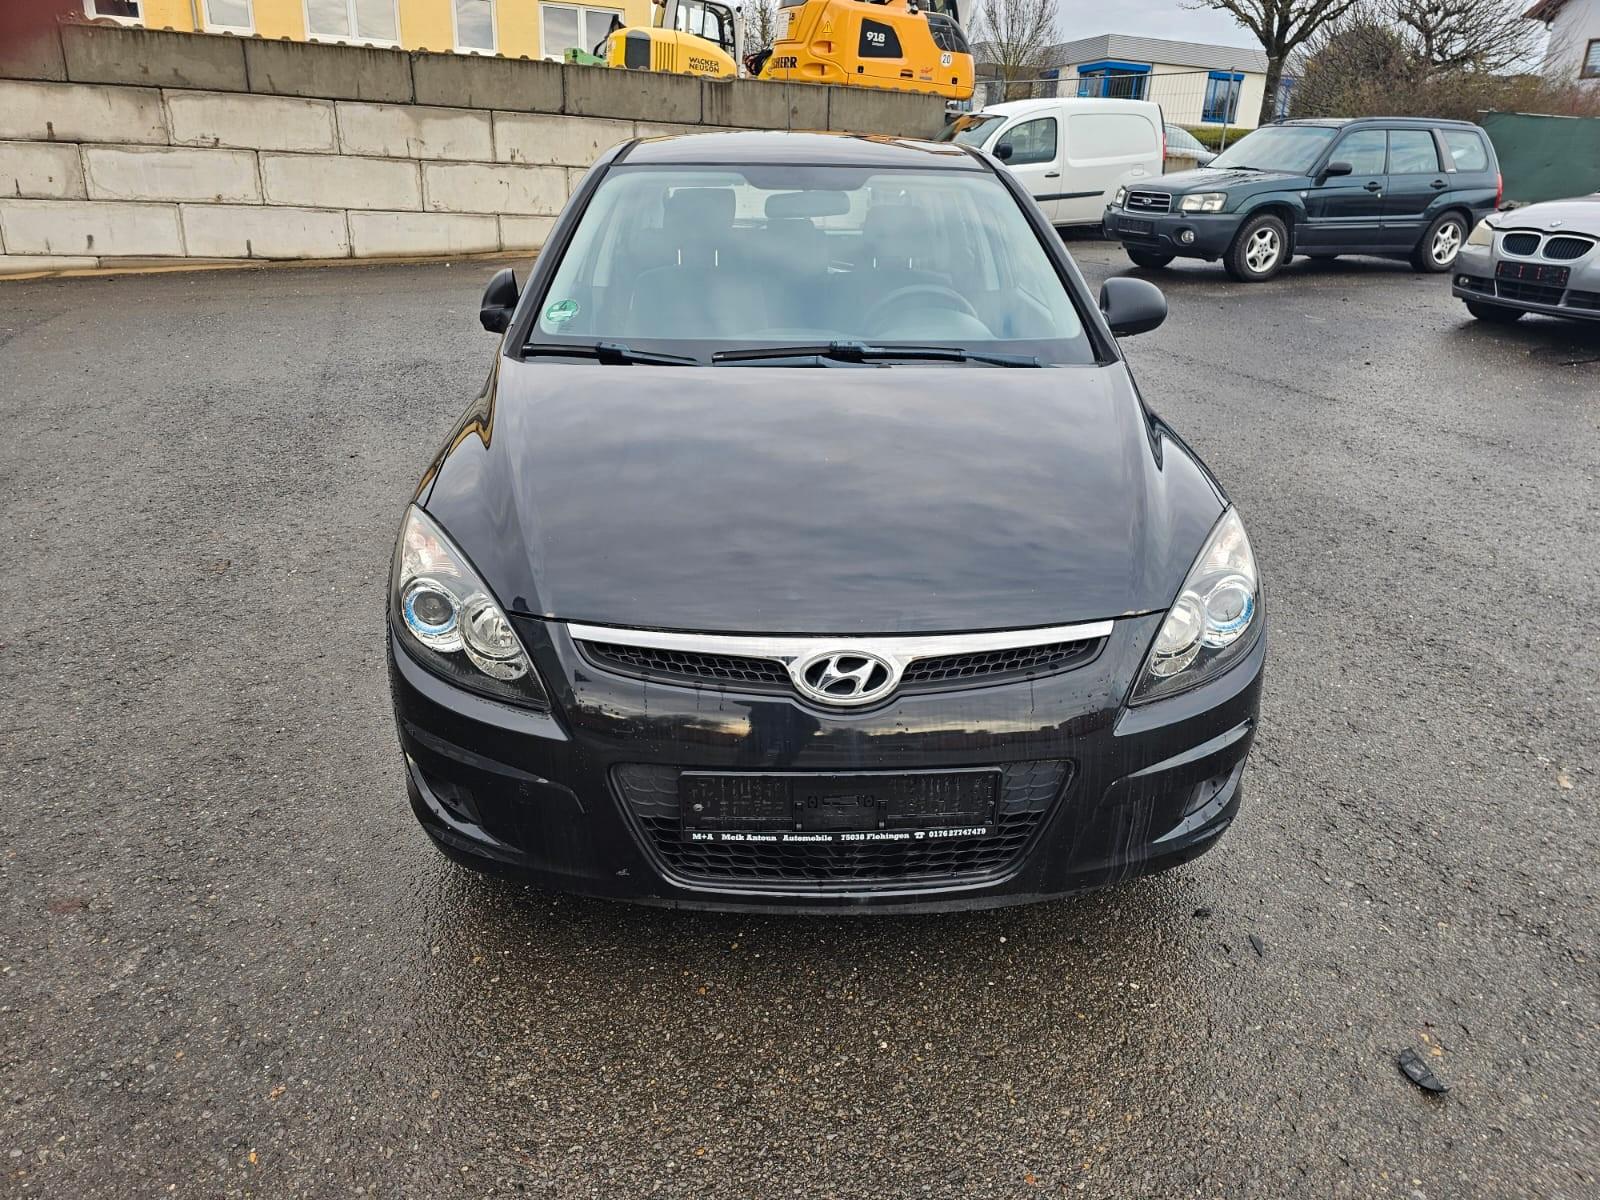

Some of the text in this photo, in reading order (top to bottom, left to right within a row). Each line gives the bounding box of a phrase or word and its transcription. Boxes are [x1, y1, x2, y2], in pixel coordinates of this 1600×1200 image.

[866, 31, 886, 43] 918
[942, 54, 951, 64] 20
[688, 63, 720, 73] NEUSON
[692, 833, 714, 841] M+A
[782, 834, 833, 842] Automobile
